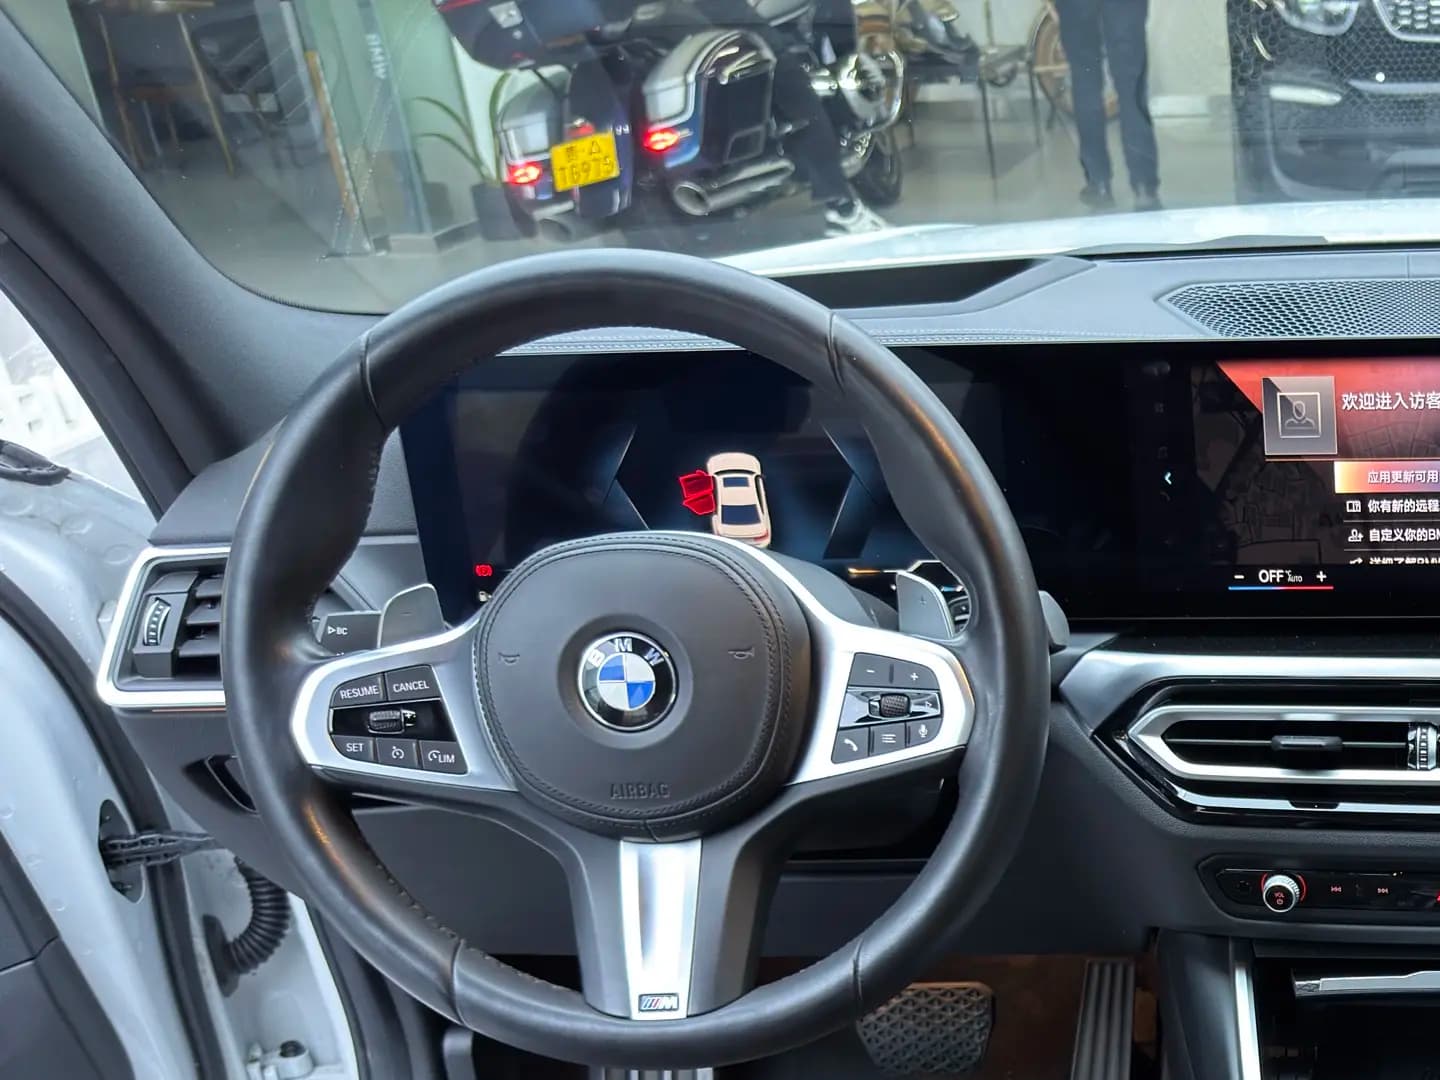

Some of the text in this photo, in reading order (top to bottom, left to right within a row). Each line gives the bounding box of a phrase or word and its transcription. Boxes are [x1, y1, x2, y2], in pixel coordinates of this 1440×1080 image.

[1367, 470, 1440, 484] 应用更新可用
[1258, 569, 1284, 583] OFF
[587, 637, 665, 668] BMW
[339, 685, 380, 700] RESUME
[392, 680, 430, 693] CANCEL
[346, 743, 364, 752] SET
[438, 754, 455, 764] LIM
[610, 783, 671, 800] AIRBAG
